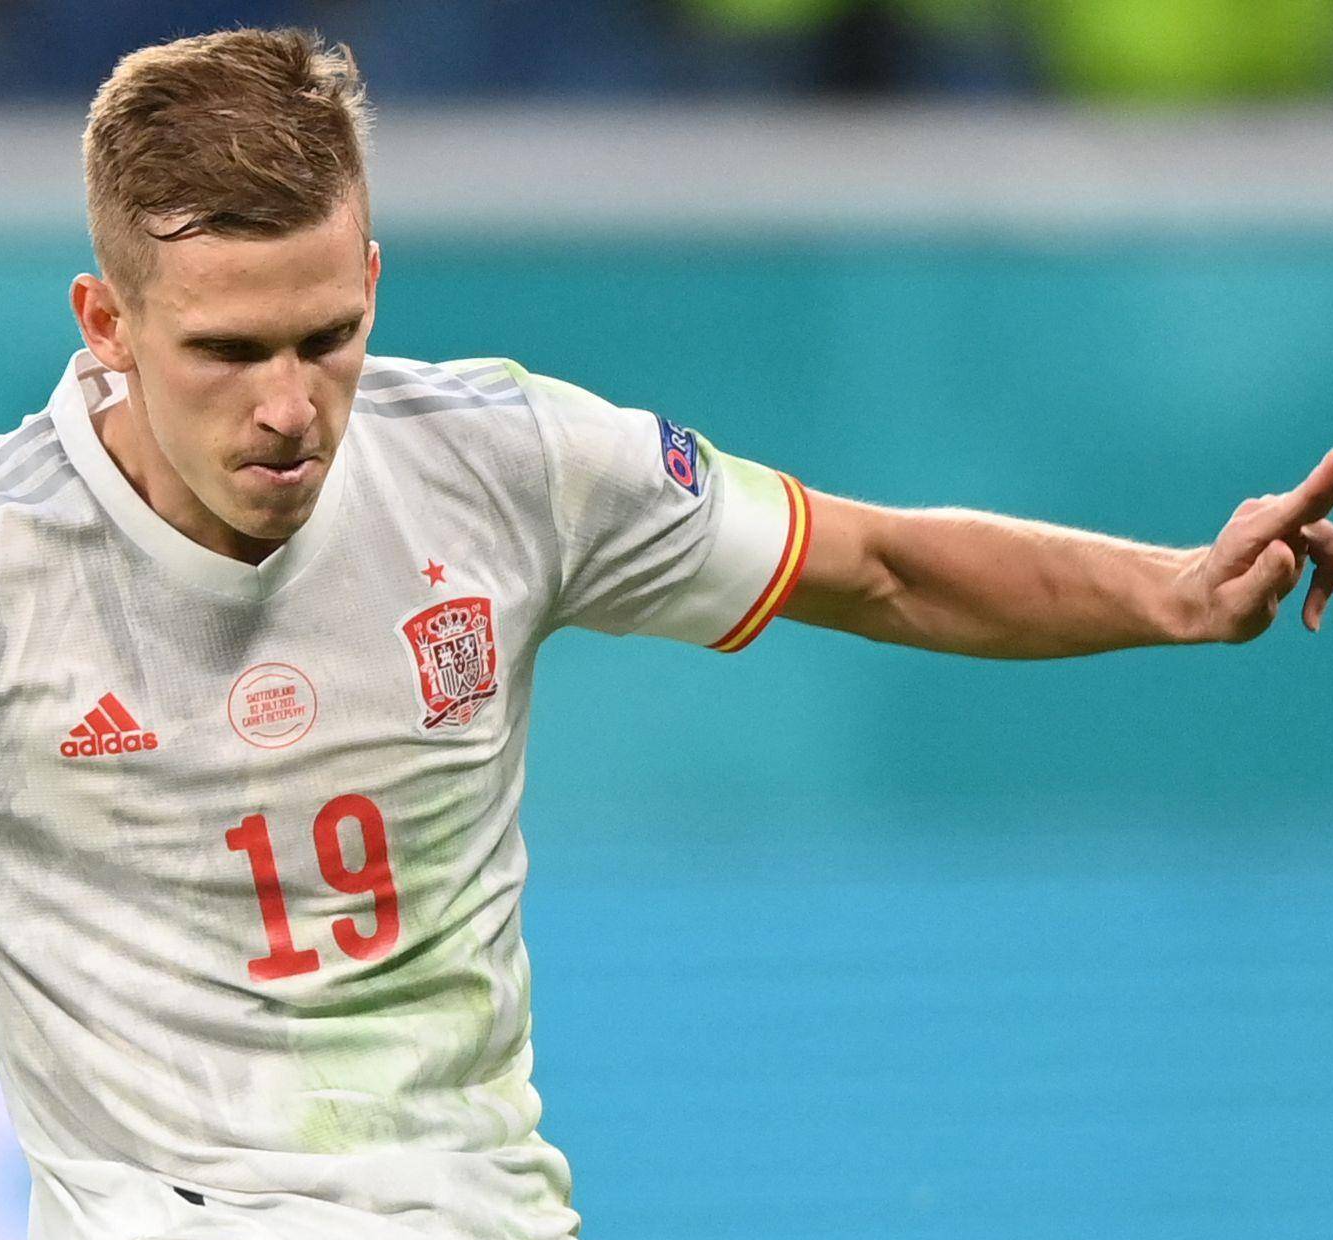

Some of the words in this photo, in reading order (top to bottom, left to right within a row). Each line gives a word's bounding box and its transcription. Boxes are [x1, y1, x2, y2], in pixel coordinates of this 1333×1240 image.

[246, 685, 296, 704] SWITZERLAND
[261, 701, 277, 712] JULY
[60, 732, 158, 757] adidas
[224, 794, 400, 982] 19
